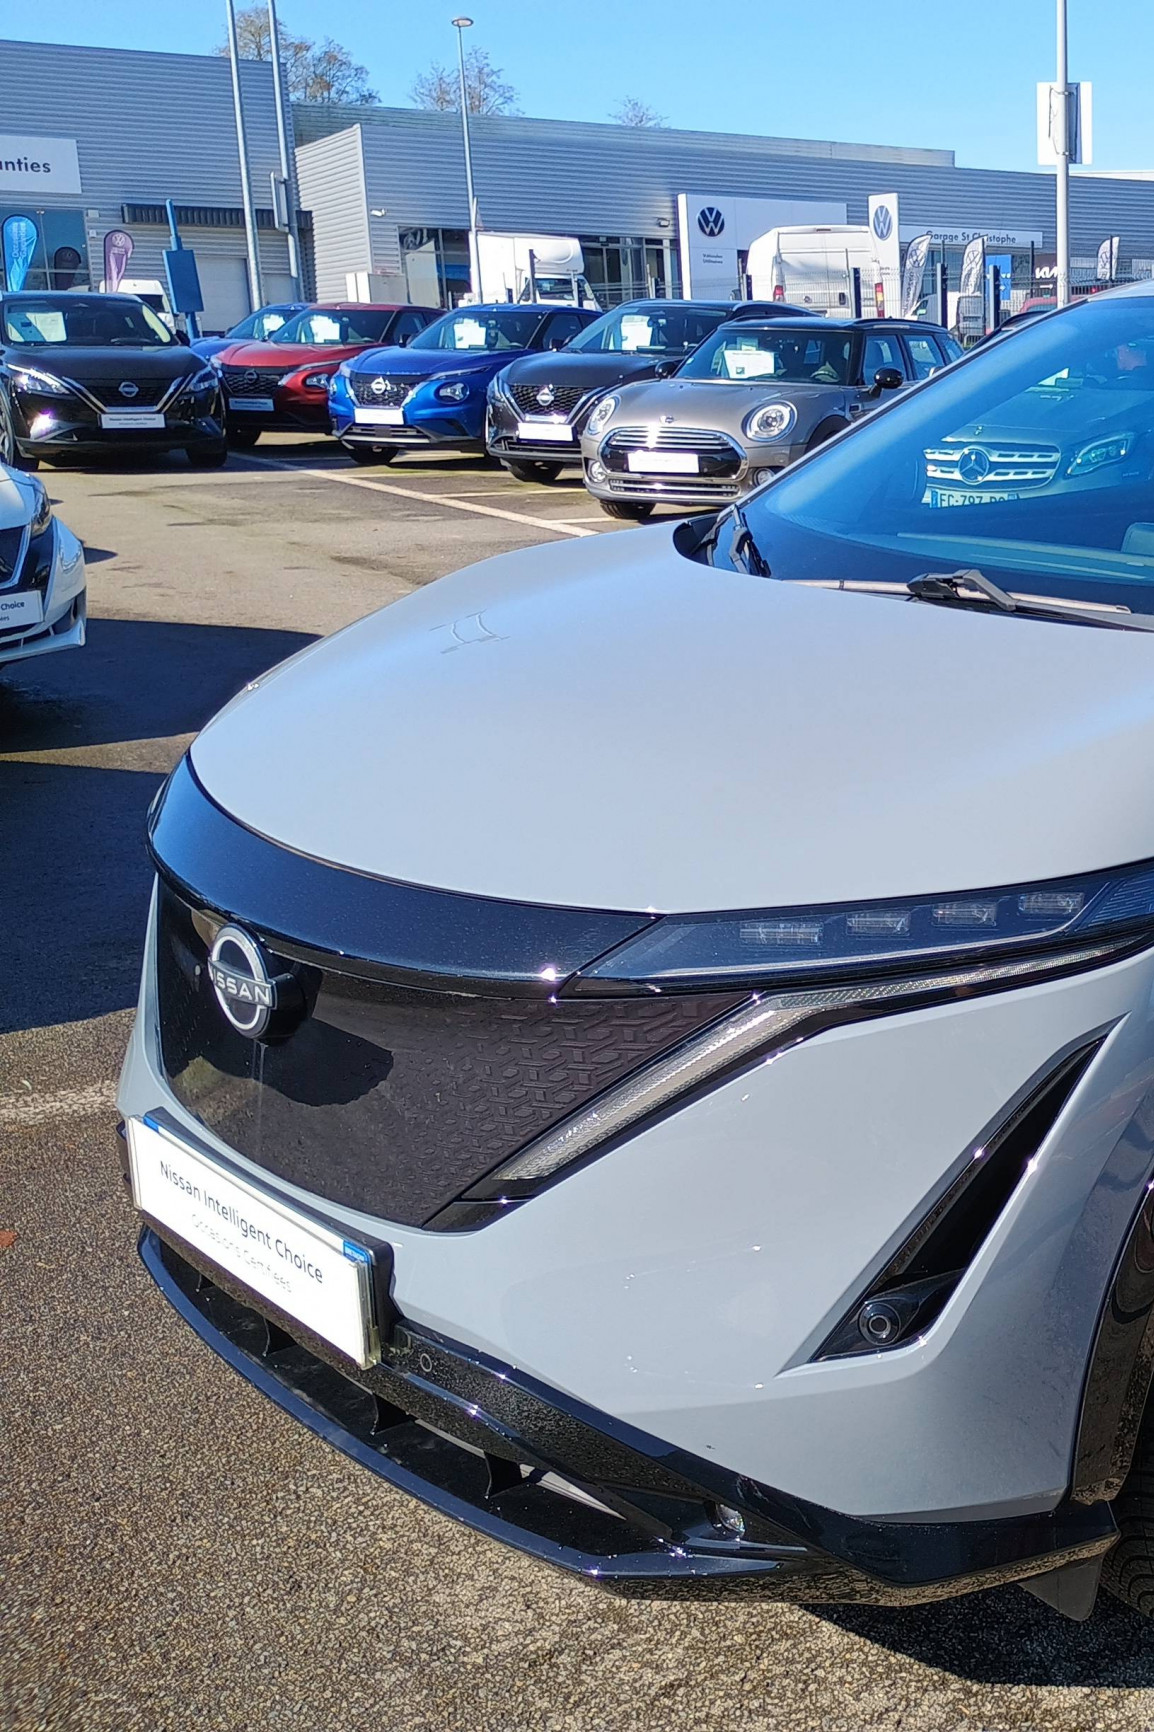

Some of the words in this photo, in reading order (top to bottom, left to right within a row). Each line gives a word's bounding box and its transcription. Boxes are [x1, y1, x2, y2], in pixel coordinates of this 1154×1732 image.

[0, 157, 51, 173] nties
[961, 232, 970, 241] St
[972, 232, 1016, 244] Cistophe
[0, 601, 25, 611] Choice
[160, 1160, 200, 1201] Nissan
[204, 1190, 272, 1250] Intelligent
[275, 1238, 323, 1284] Choice
